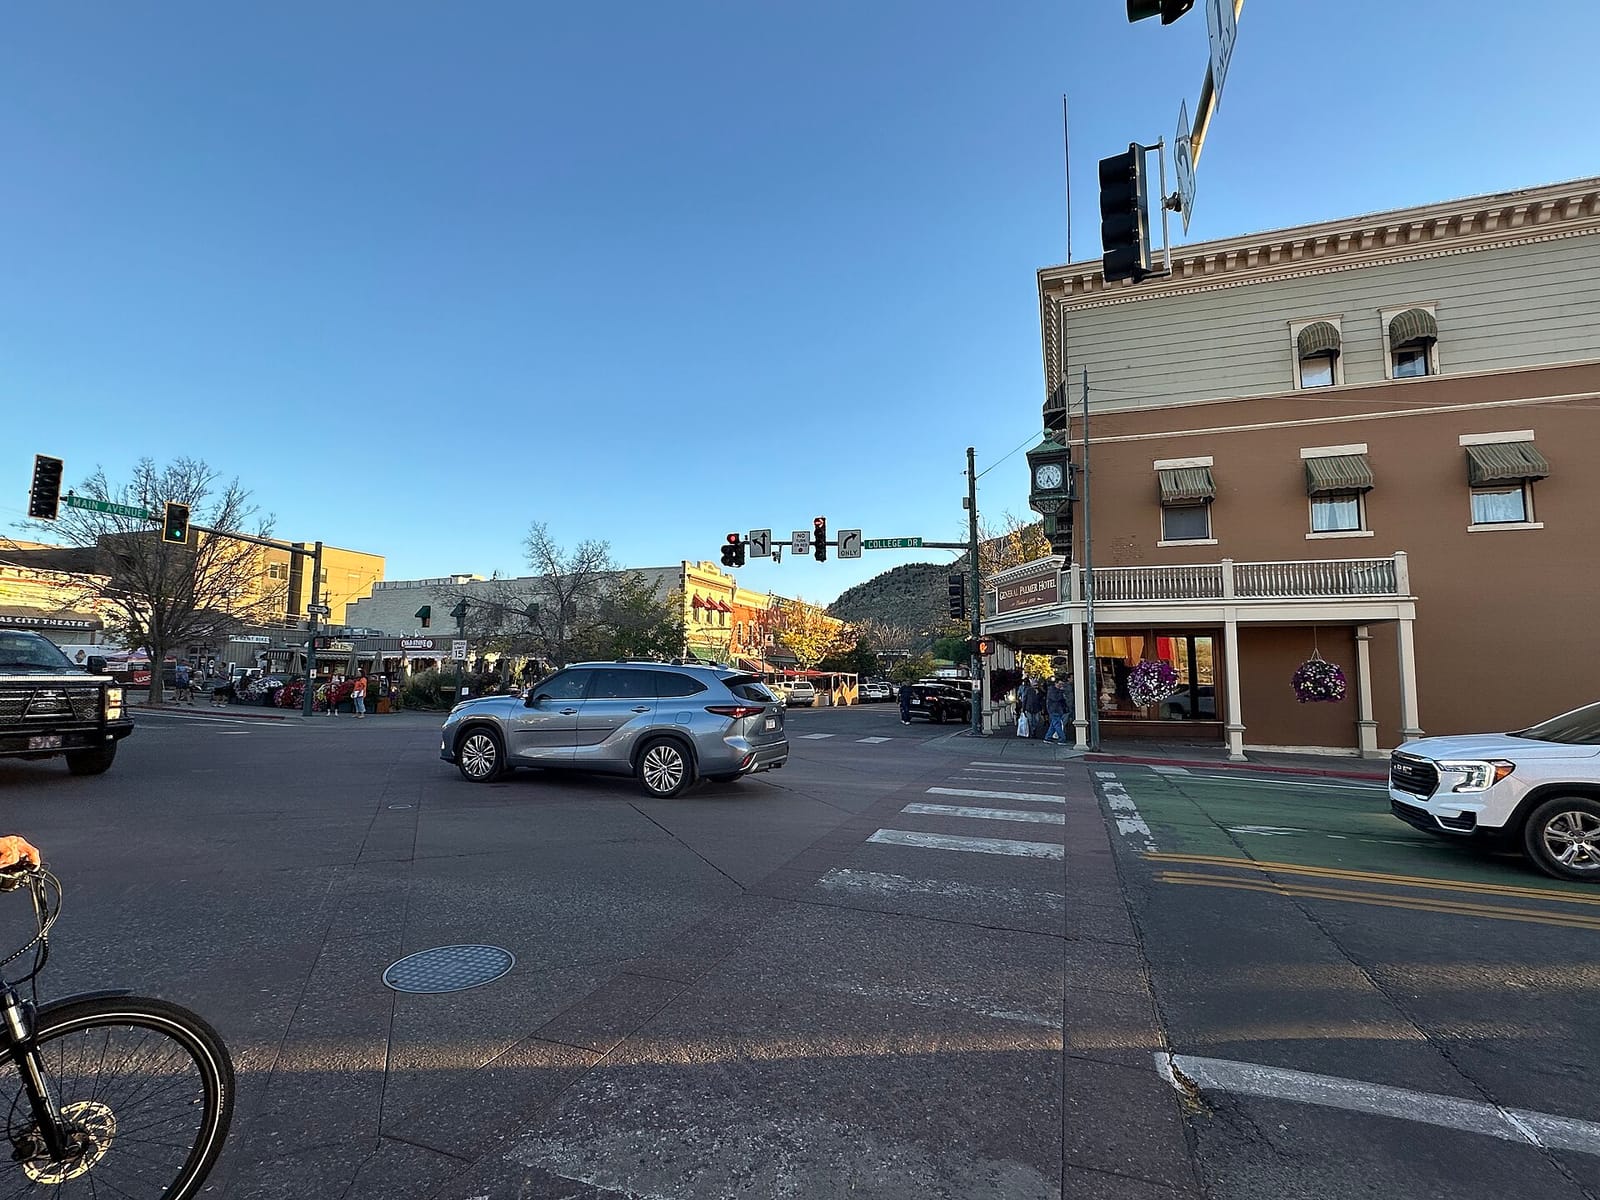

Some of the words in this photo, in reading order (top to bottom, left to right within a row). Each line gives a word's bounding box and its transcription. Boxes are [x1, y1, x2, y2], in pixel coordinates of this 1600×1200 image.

[1216, 14, 1231, 90] ONLY
[73, 498, 98, 510] MAIN
[105, 504, 143, 517] AVENUE
[868, 539, 902, 549] COLLEGE
[907, 538, 919, 547] DR
[1020, 584, 1037, 595] PALMER
[1038, 579, 1056, 591] HOTEL
[42, 619, 91, 627] THEATRE
[455, 650, 464, 658] 15
